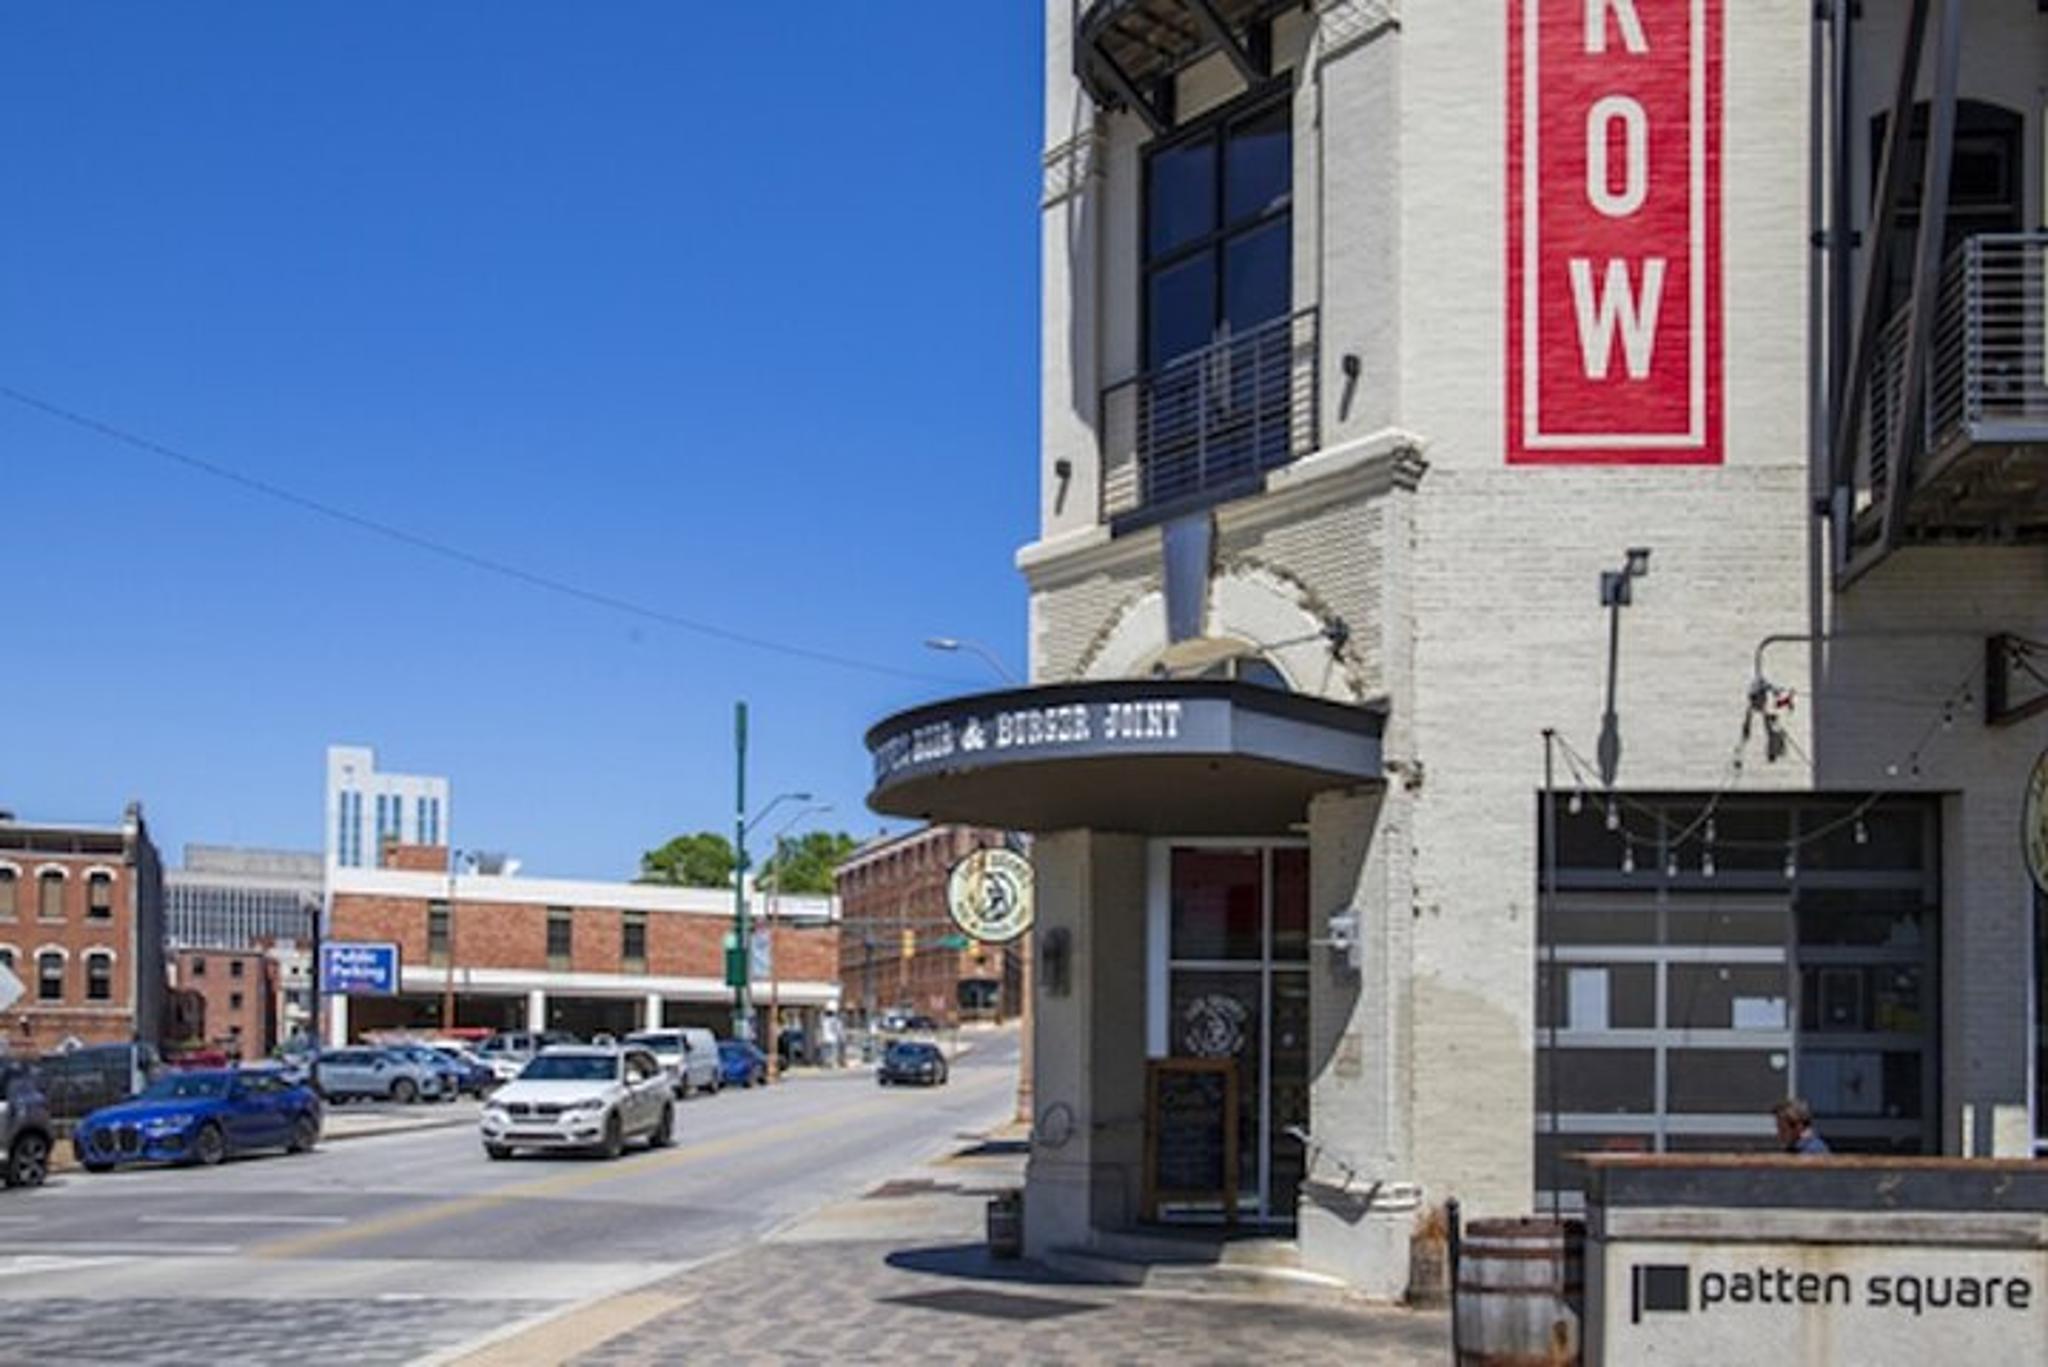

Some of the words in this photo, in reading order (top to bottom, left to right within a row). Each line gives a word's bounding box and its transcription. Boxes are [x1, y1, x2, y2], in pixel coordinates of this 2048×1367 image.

[960, 716, 986, 750] &
[1105, 702, 1181, 739] JOINT
[1700, 1267, 1851, 1311] patten
[1867, 1275, 2032, 1315] square
